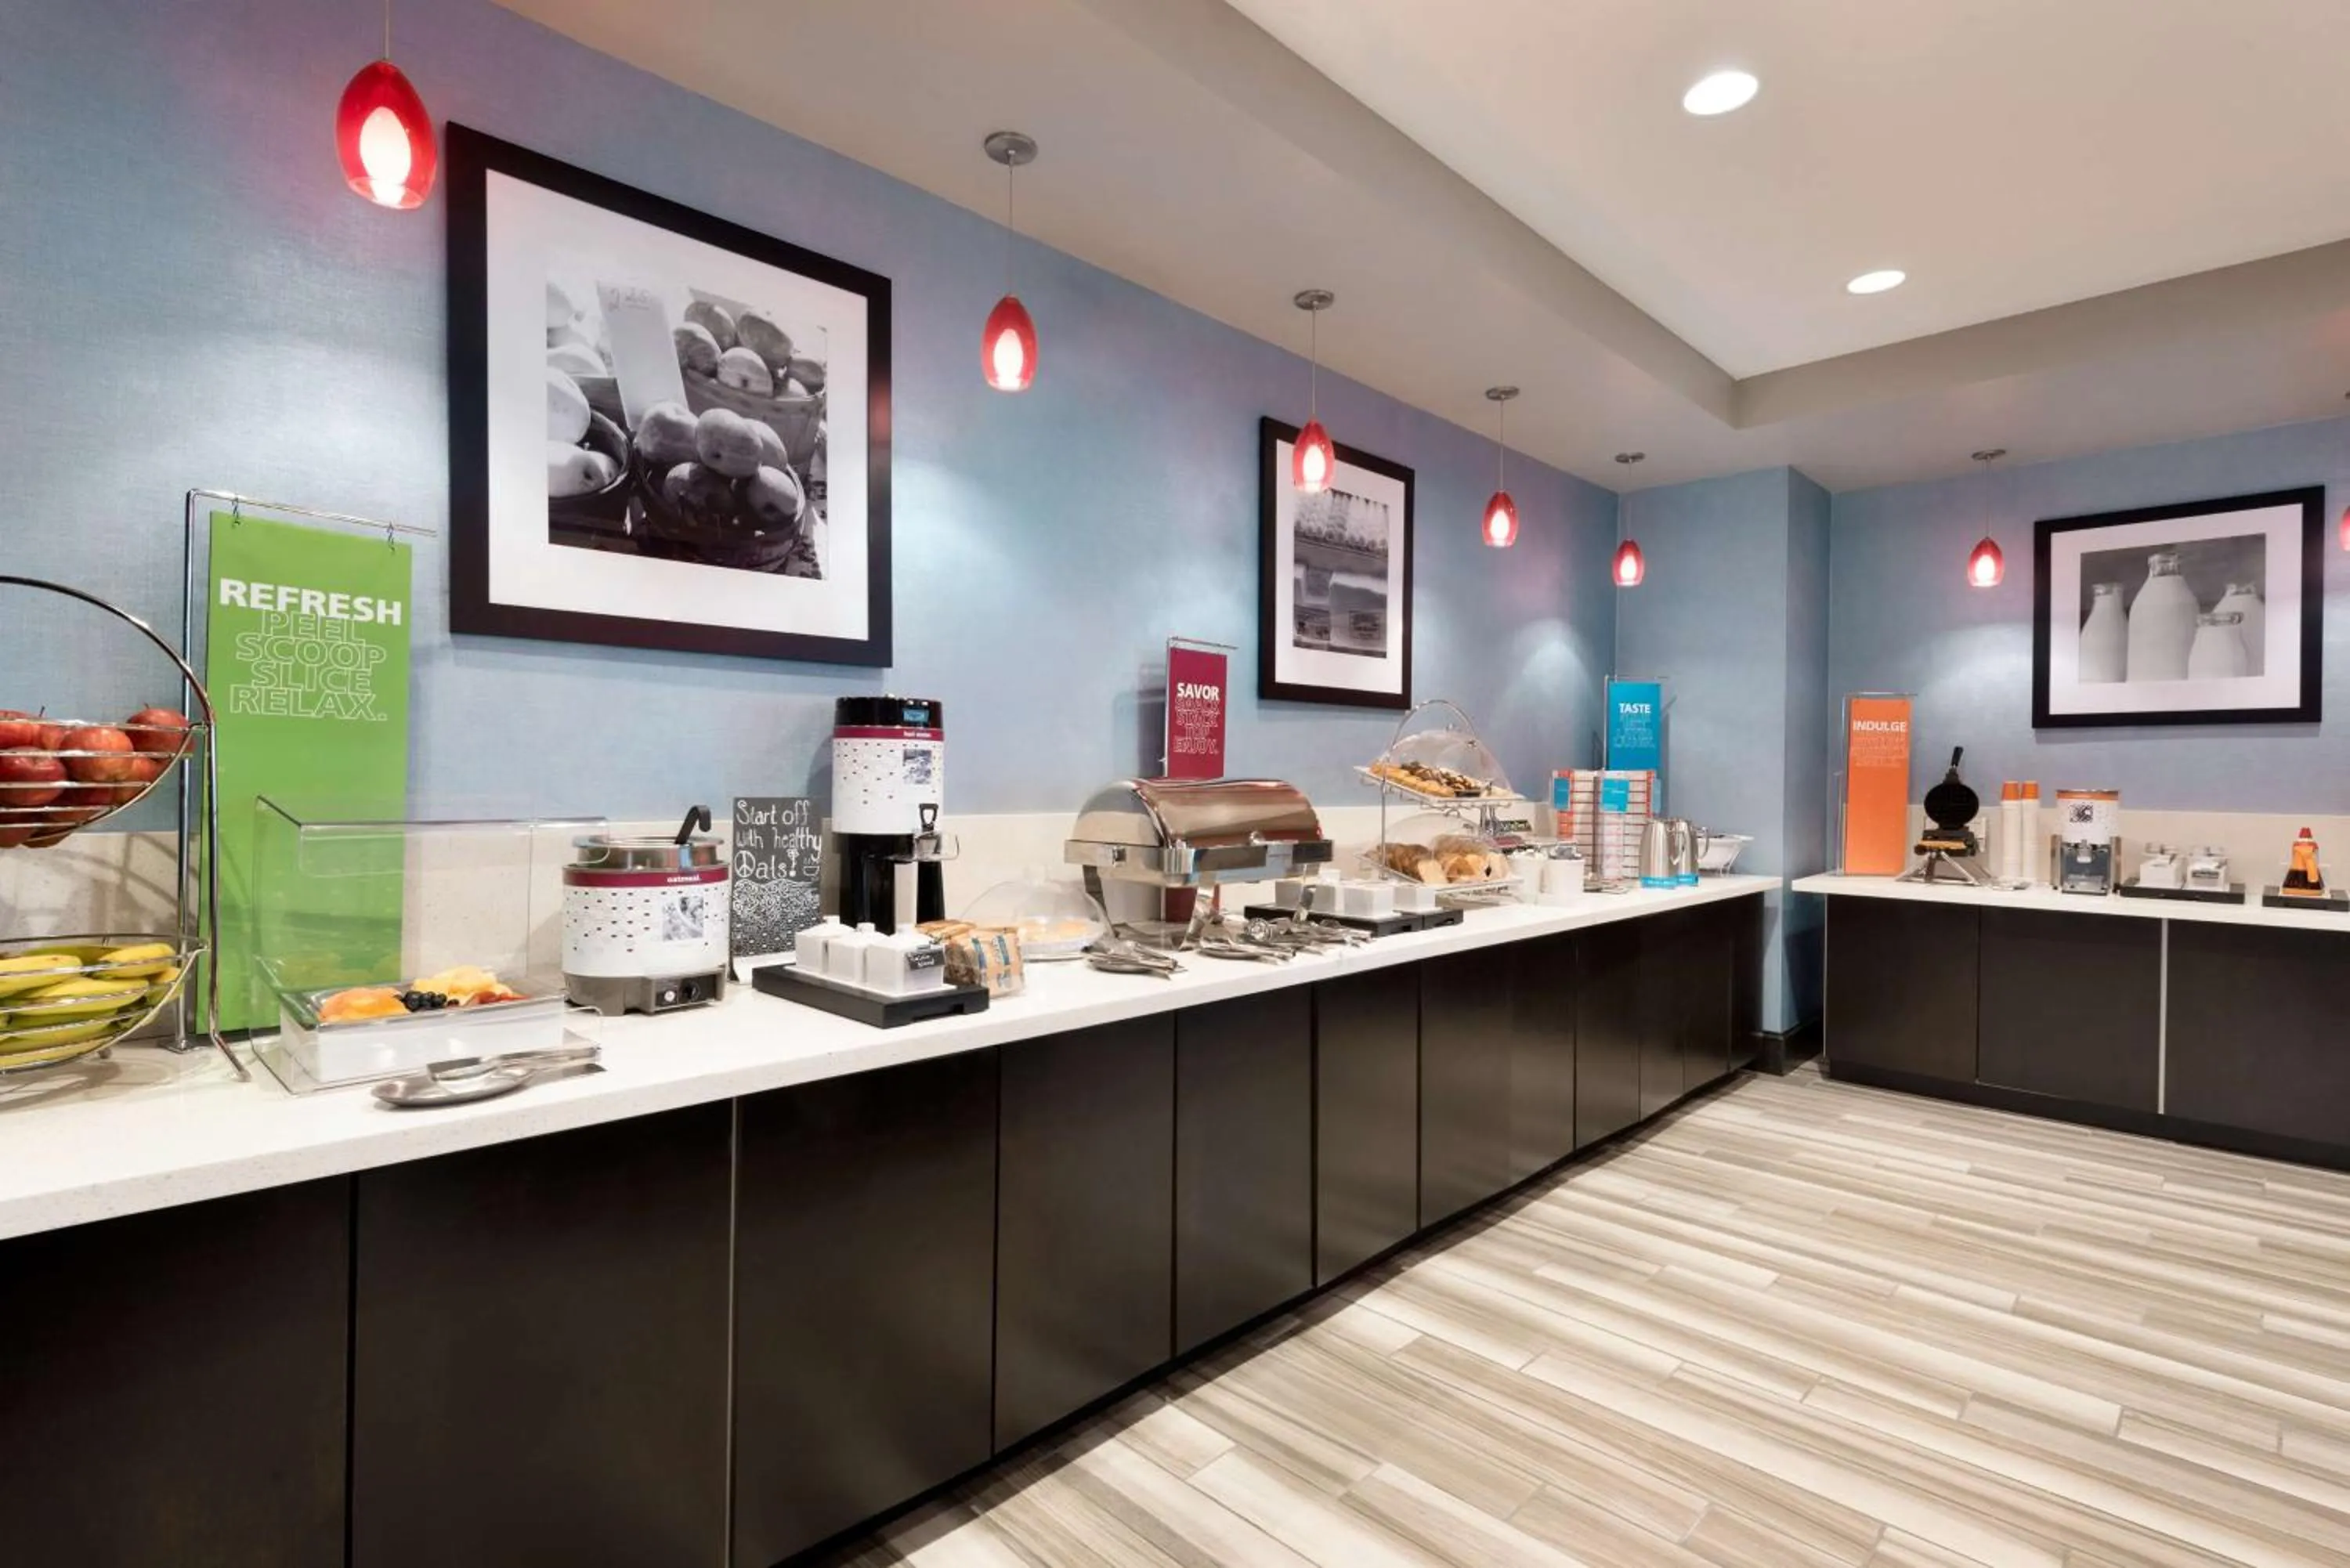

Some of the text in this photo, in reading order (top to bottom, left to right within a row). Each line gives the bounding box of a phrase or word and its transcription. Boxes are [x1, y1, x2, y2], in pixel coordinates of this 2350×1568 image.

[219, 578, 401, 625] REFRESH
[262, 609, 365, 645] PEEL
[236, 632, 386, 671] SCOOP
[251, 660, 371, 695] SLICE
[1177, 682, 1220, 700] SAVOR
[230, 684, 388, 721] RELAX.
[1618, 703, 1651, 714] TASTE
[1853, 720, 1907, 732] INDULGE
[736, 800, 810, 826] Start off
[772, 826, 822, 862] healthy
